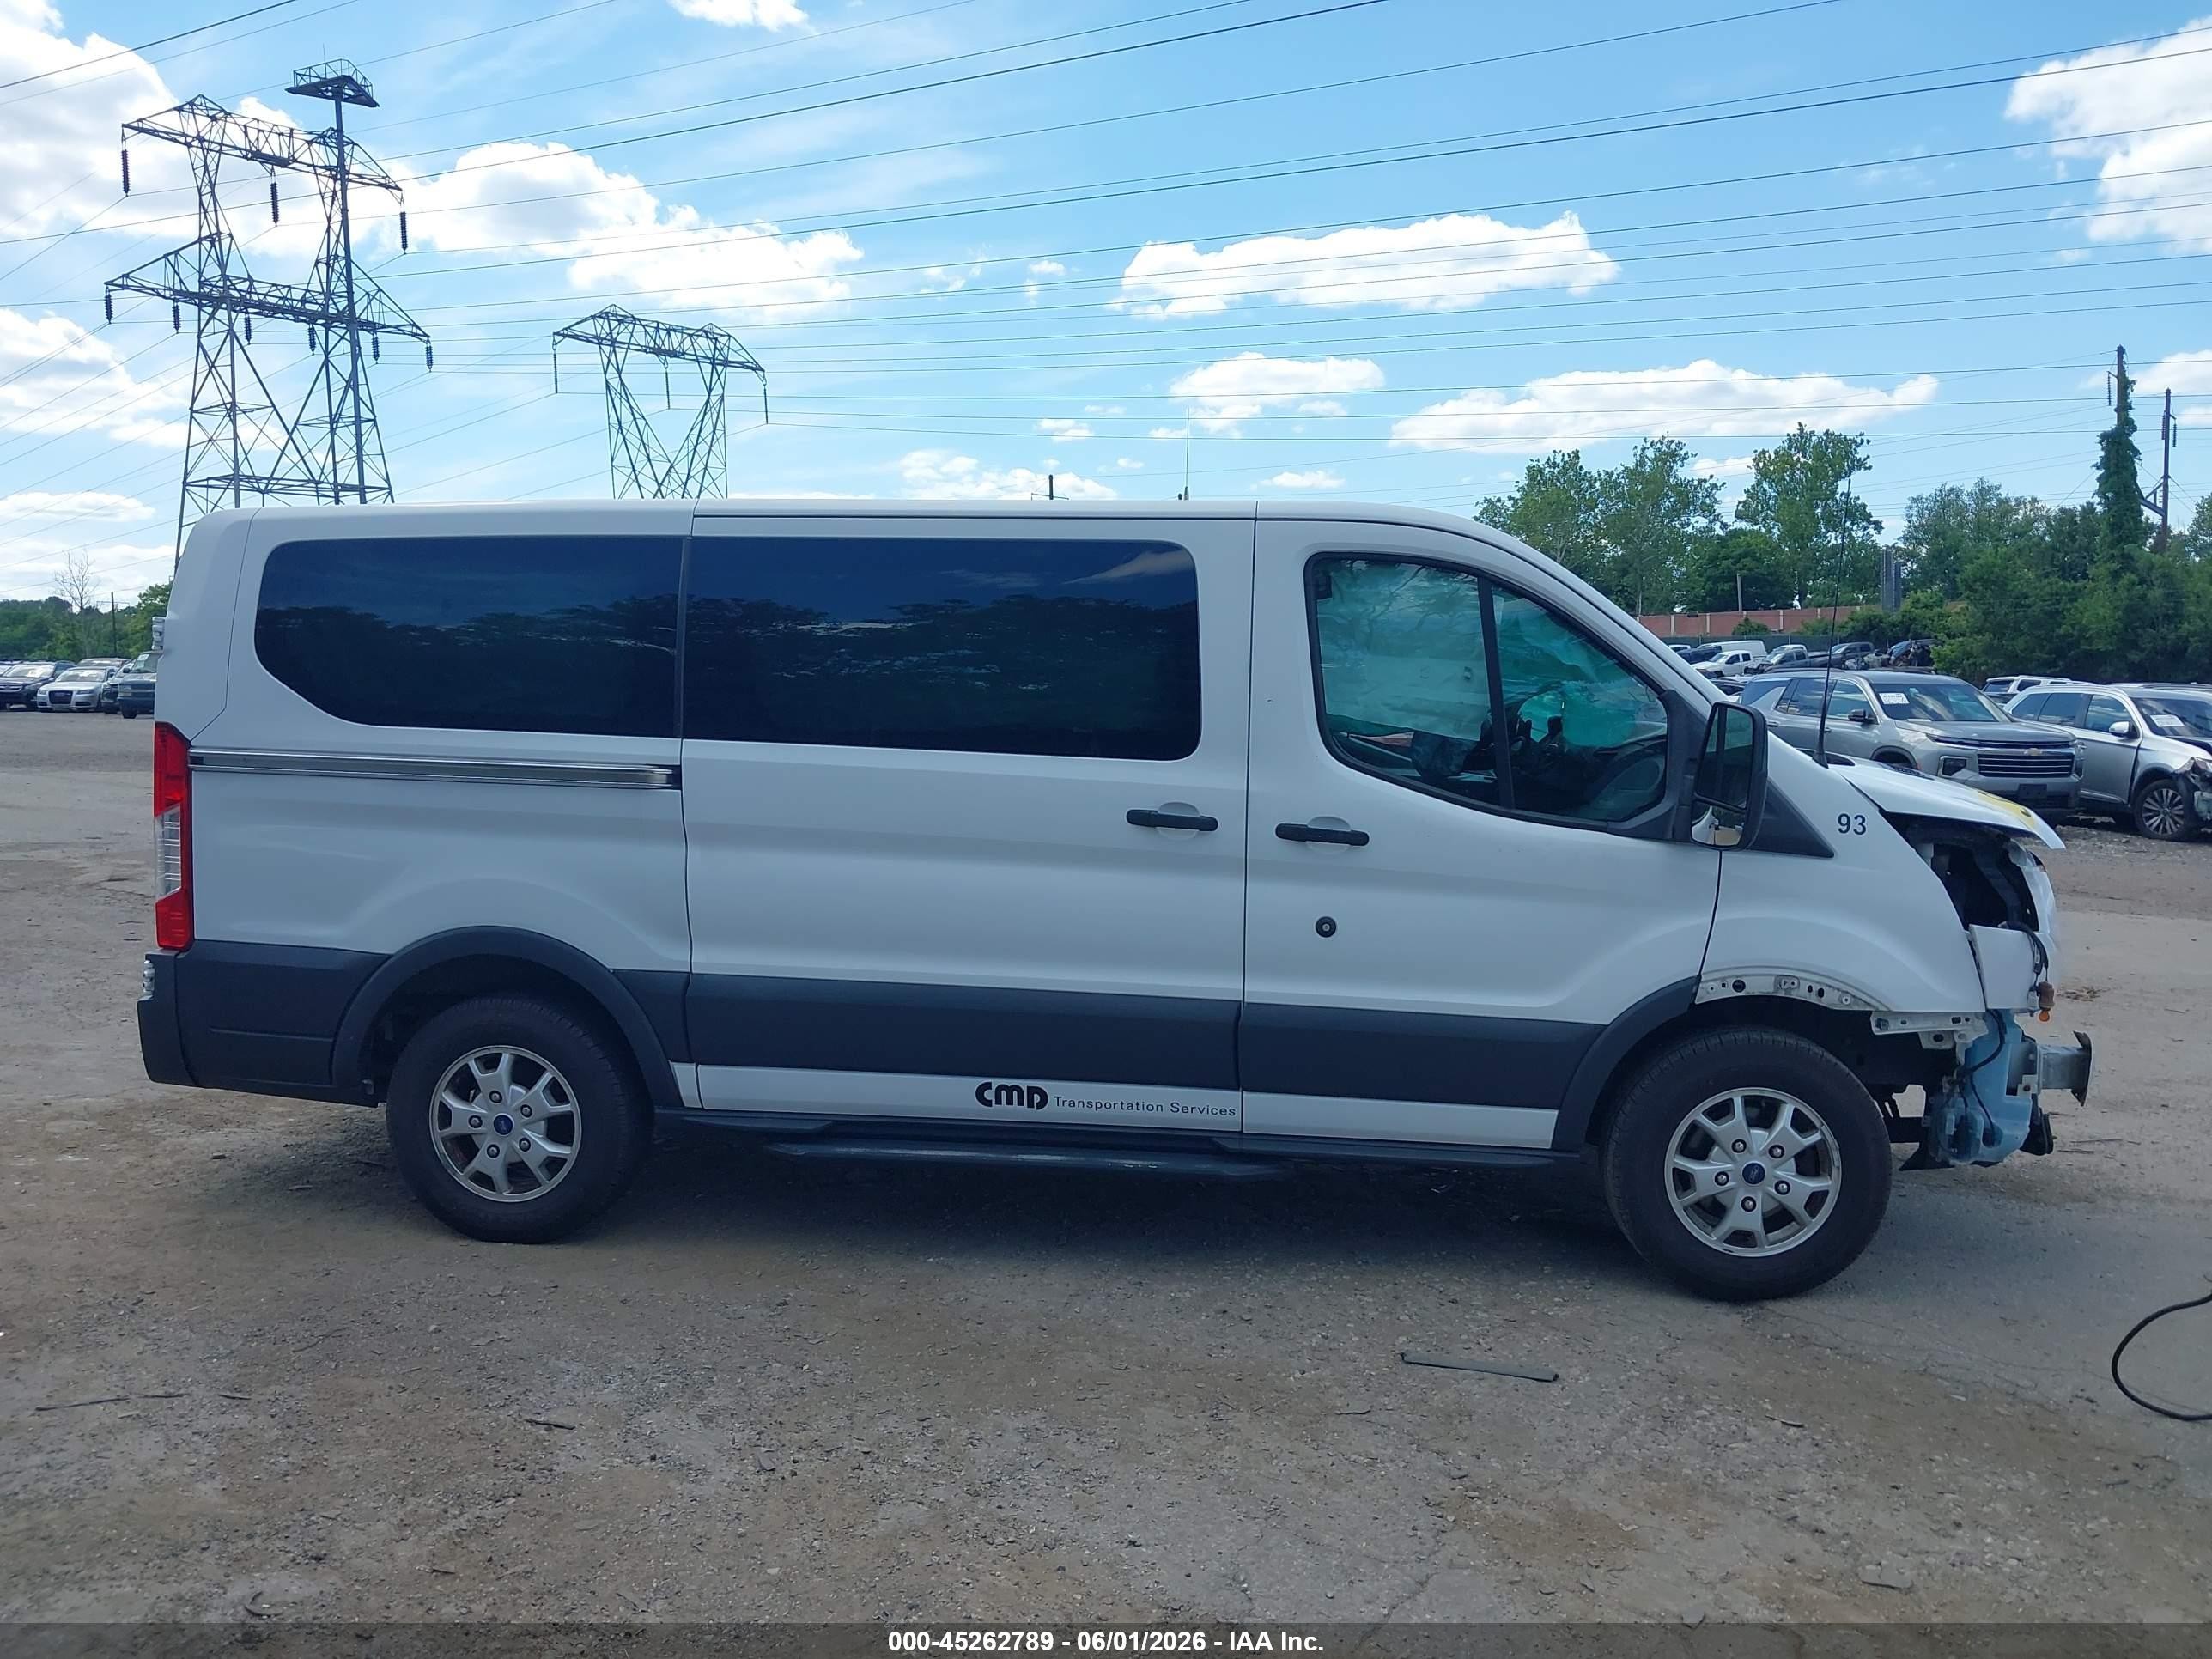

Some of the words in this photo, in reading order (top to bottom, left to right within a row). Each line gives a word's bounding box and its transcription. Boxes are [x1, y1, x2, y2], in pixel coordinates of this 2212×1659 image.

[1838, 813, 1867, 836] 93
[1054, 1096, 1164, 1113] Transportation
[1170, 1102, 1237, 1116] Services
